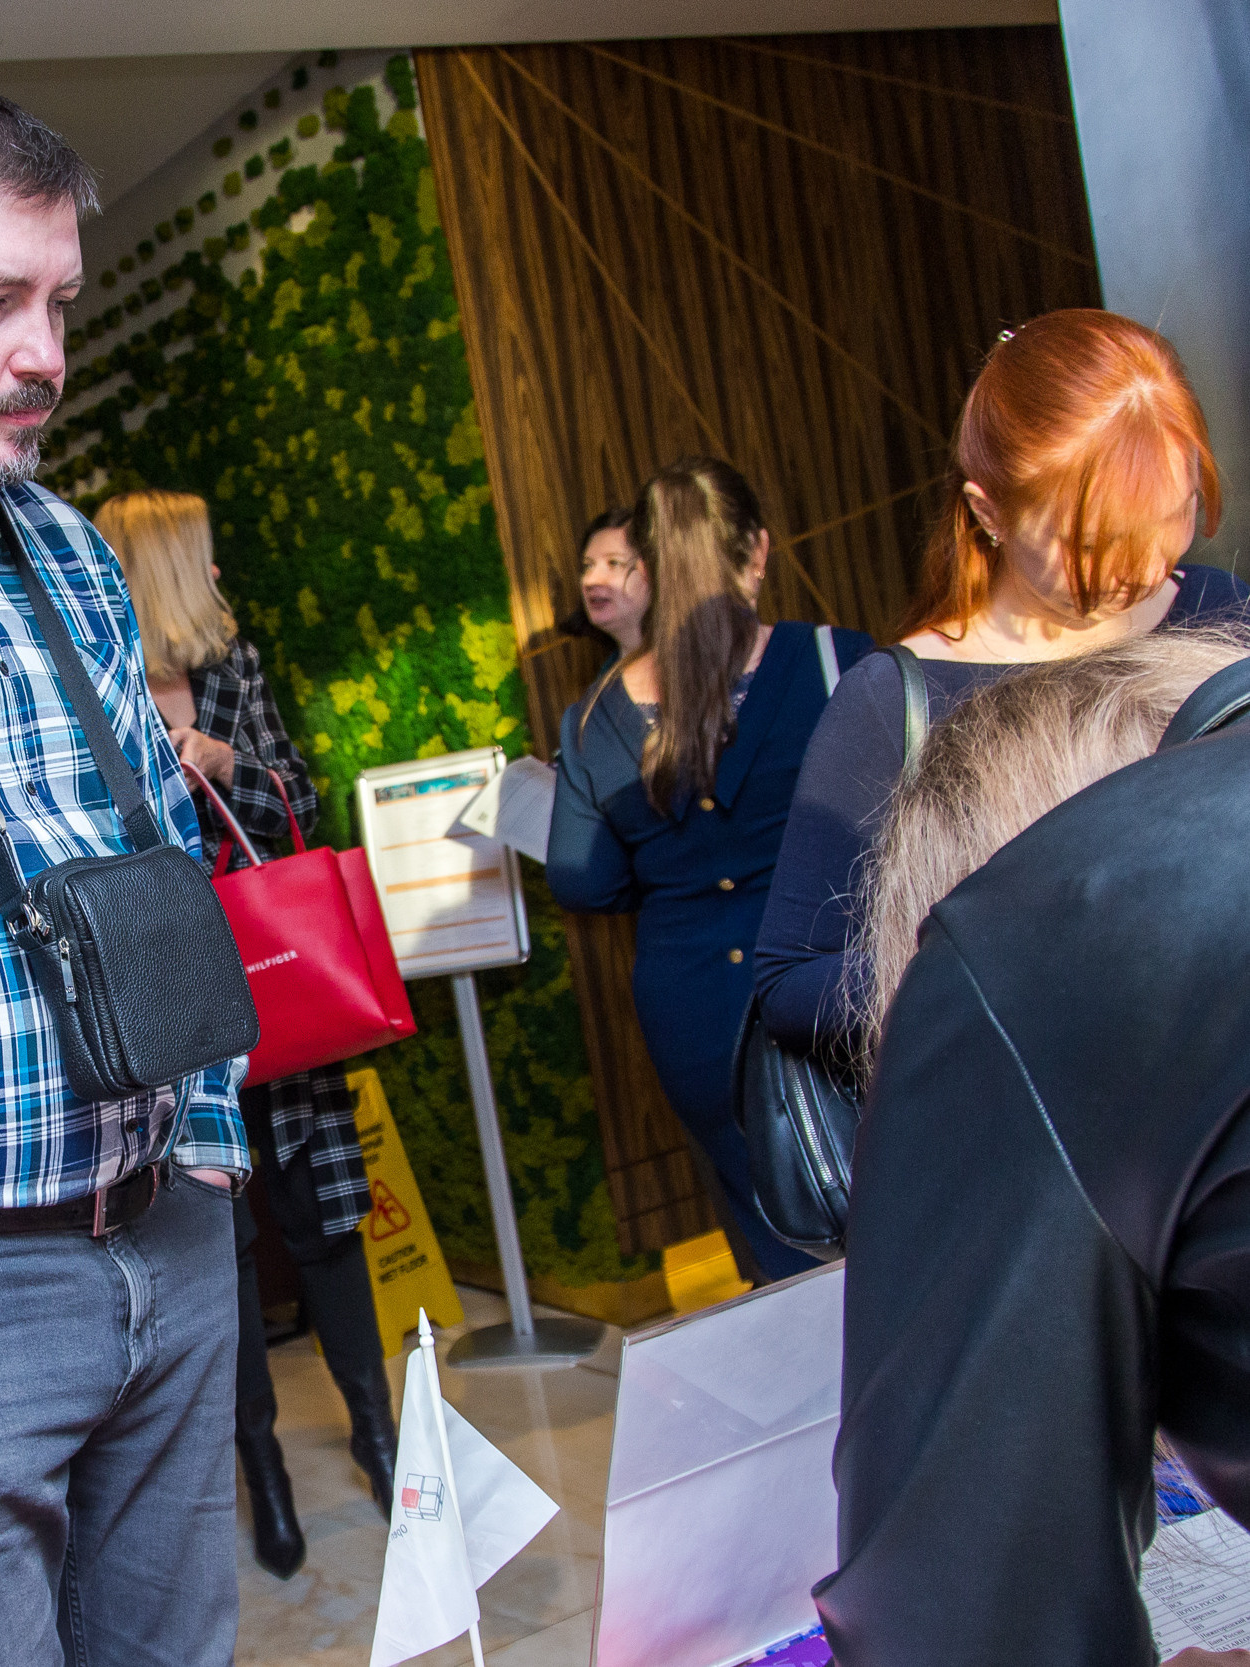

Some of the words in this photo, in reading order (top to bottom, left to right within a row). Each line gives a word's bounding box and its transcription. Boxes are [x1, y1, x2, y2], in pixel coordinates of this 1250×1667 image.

[246, 950, 298, 974] HILFIGER
[378, 1243, 417, 1268] CAUTION
[378, 1268, 398, 1283] WET
[398, 1253, 429, 1273] FLOOR
[1176, 1605, 1201, 1617] ПОЧТА
[1199, 1593, 1228, 1608] РОССИИ
